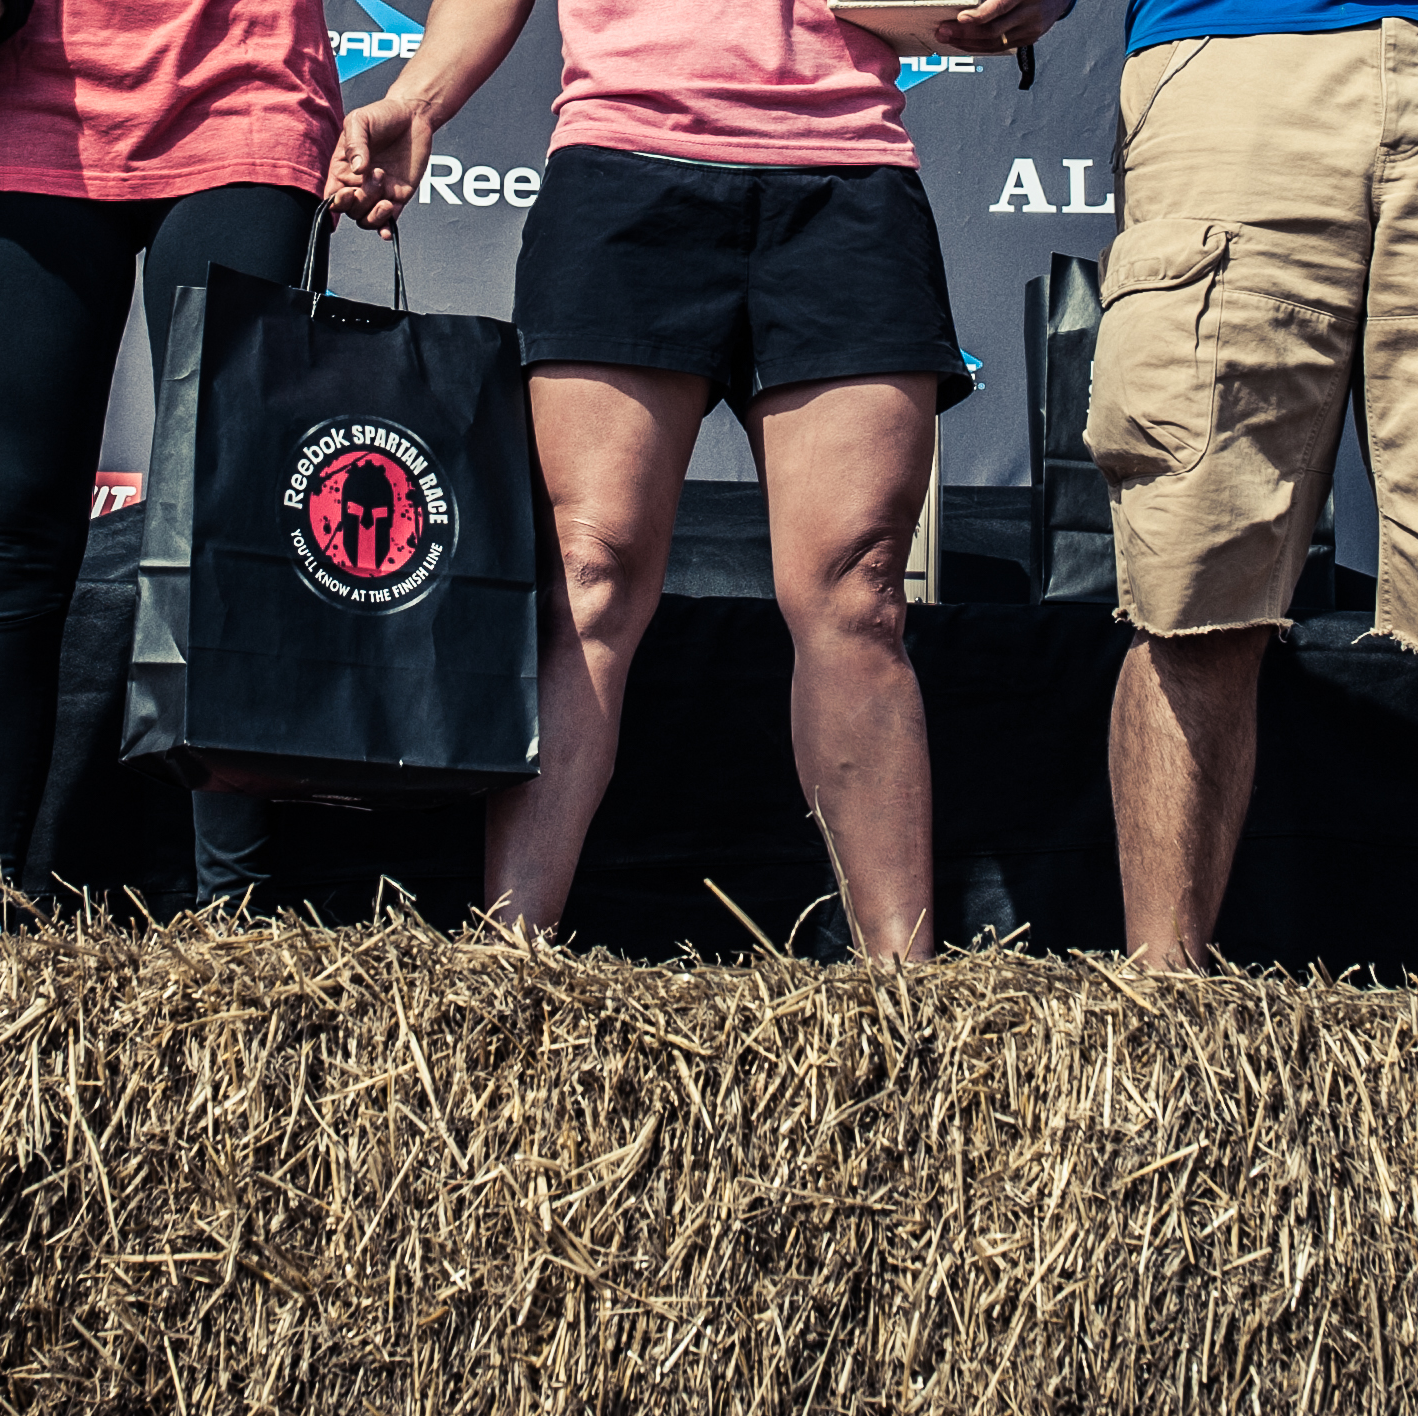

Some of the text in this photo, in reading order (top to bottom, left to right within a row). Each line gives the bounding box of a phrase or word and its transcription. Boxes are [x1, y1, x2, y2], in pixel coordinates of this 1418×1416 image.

[284, 425, 448, 524] Reebok SPARTAN RACE
[291, 529, 443, 603] YOU'LL KNOW AT THE FINISH LINE
